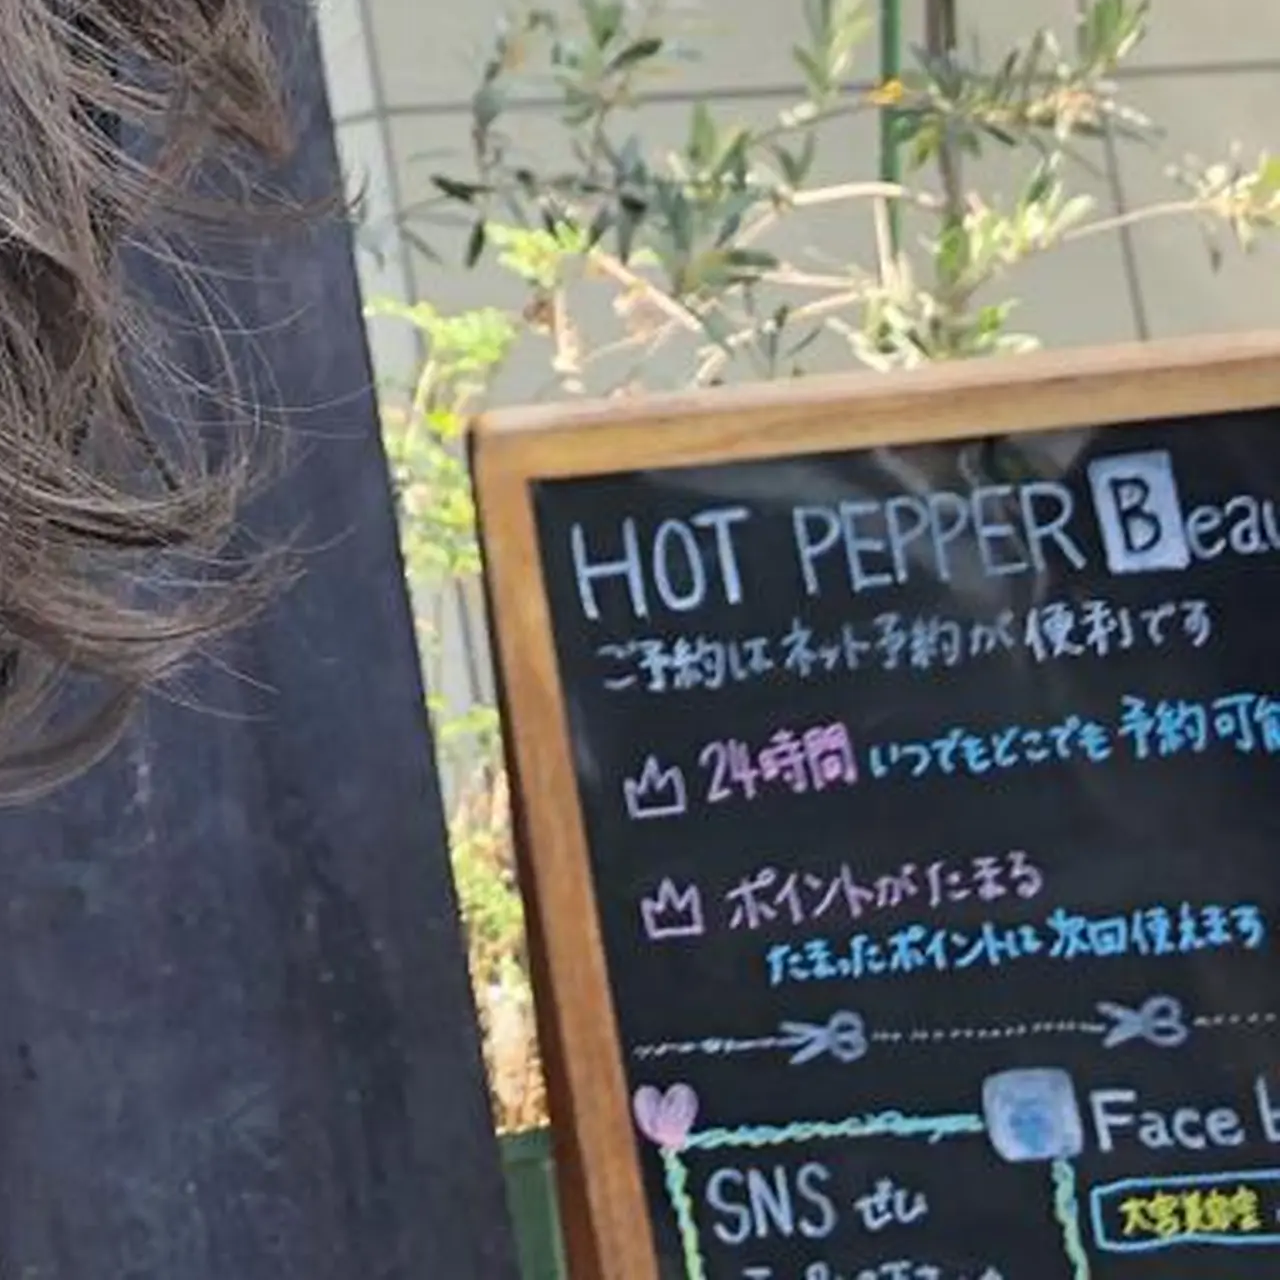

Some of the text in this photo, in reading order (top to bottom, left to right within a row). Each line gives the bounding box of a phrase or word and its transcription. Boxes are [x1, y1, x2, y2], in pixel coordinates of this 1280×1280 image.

[570, 505, 750, 622] HOT
[792, 480, 1088, 596] PEPPER
[698, 720, 859, 803] 24時間
[723, 848, 1043, 931] ポイントがたまる
[705, 1161, 837, 1245] SNS
